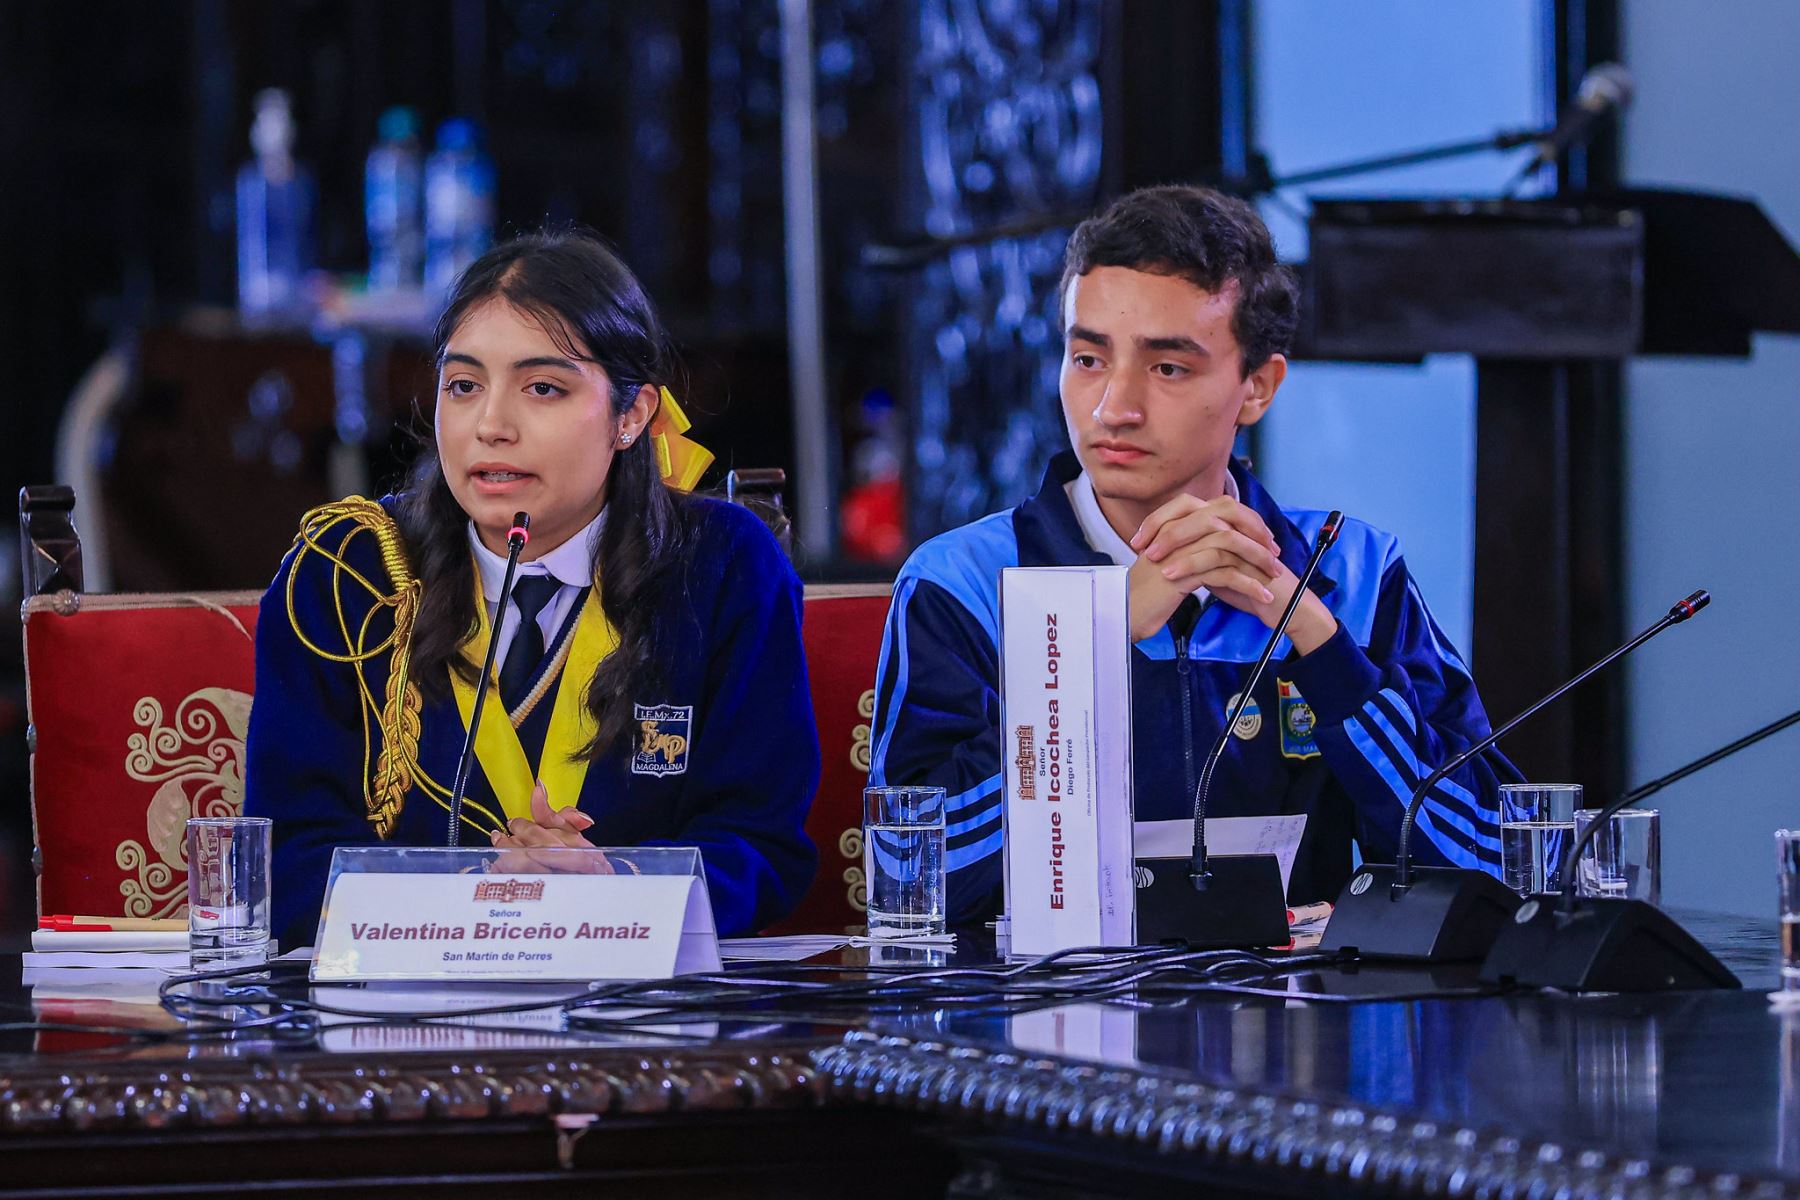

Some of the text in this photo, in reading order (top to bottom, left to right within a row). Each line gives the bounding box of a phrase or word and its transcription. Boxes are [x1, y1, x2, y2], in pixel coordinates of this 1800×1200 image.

[636, 763, 684, 771] MAGDALENA
[1045, 613, 1065, 910] Enrique Icochea Lopez
[1065, 738, 1075, 796] Diego Ferré
[488, 908, 522, 918] Señora
[350, 921, 650, 940] Valentina Briceño Amaiz
[442, 951, 464, 961] San
[501, 951, 515, 961] de
[516, 951, 553, 961] Porres
